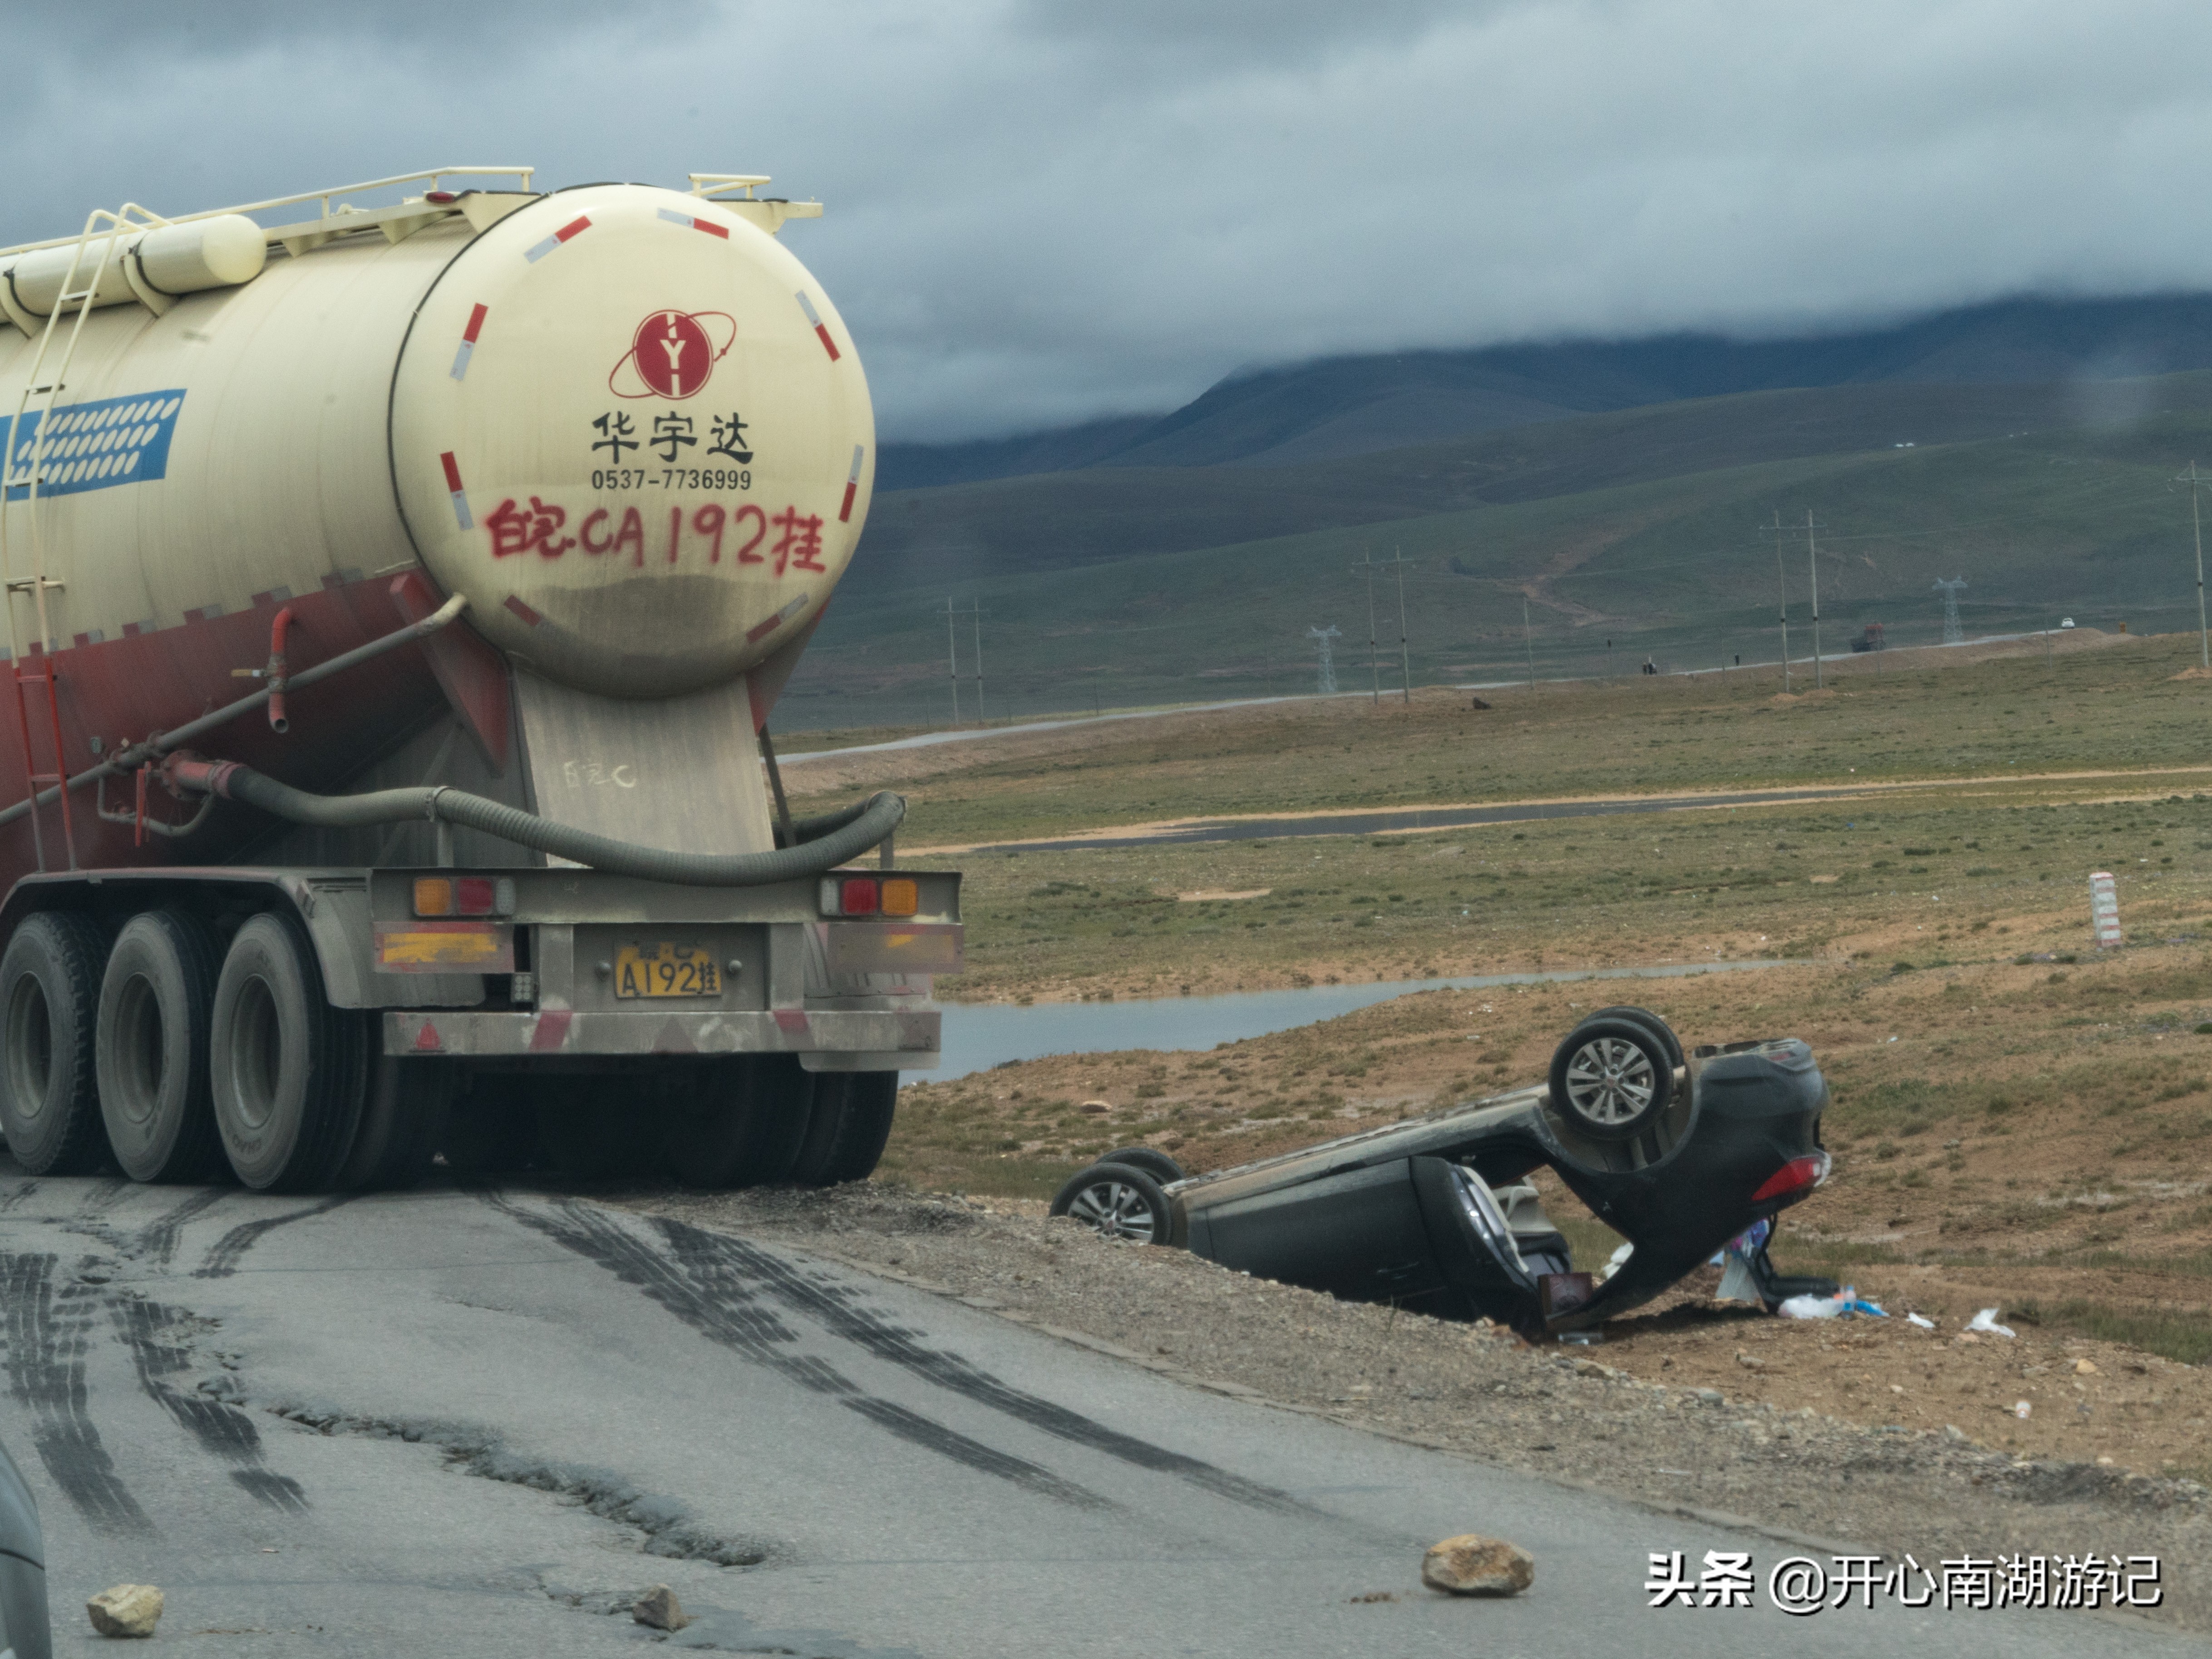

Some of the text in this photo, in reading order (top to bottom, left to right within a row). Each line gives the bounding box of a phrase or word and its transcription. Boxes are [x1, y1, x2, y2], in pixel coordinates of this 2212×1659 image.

[591, 411, 754, 465] 华宇达
[591, 469, 752, 490] 0537-7736999
